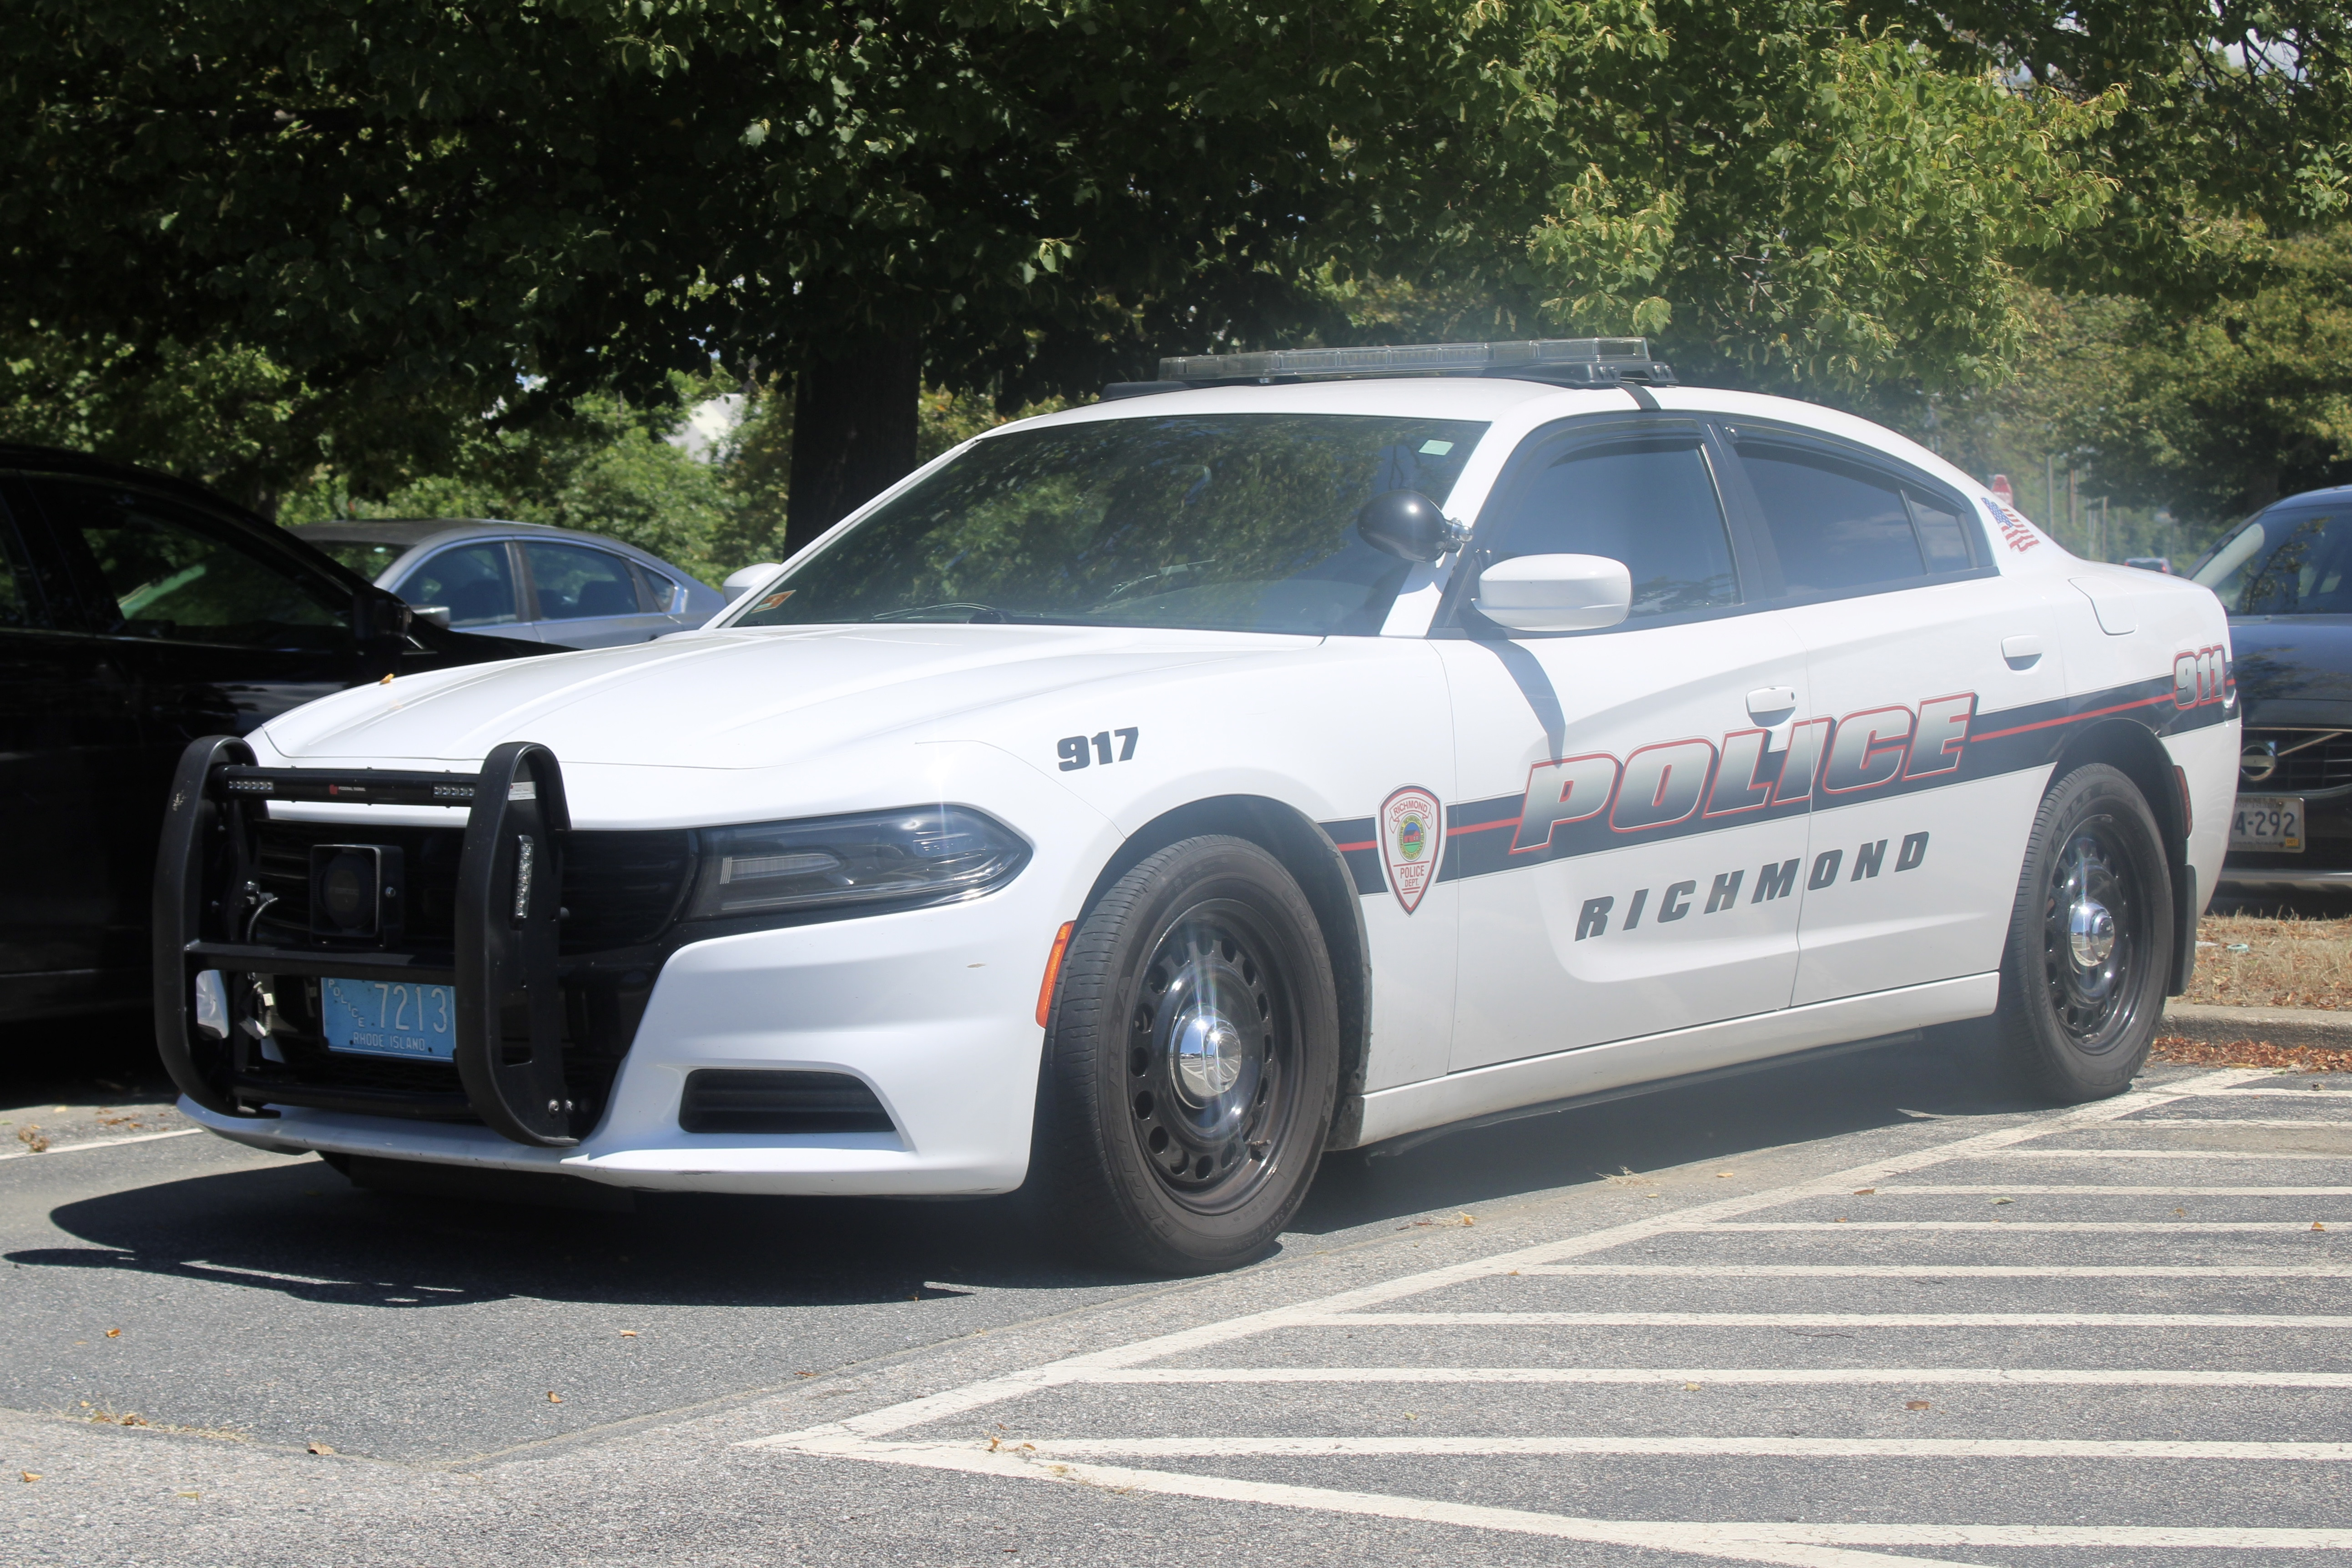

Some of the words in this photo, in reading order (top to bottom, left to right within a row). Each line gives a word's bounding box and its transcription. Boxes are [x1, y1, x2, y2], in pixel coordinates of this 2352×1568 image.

[2174, 644, 2226, 710] 911
[1057, 726, 1139, 771] 917
[1508, 691, 1979, 855] POLICE
[1393, 801, 1427, 816] RICHMOND
[2235, 812, 2295, 837] 4-292
[1400, 865, 1424, 879] POLICE
[1405, 878, 1419, 887] DEPT.
[1574, 831, 1929, 942] RICHMOND
[328, 979, 365, 1028] POLICE
[374, 983, 448, 1033] 7213
[353, 1032, 384, 1047] RHODE
[390, 1036, 425, 1051] ISLAND
